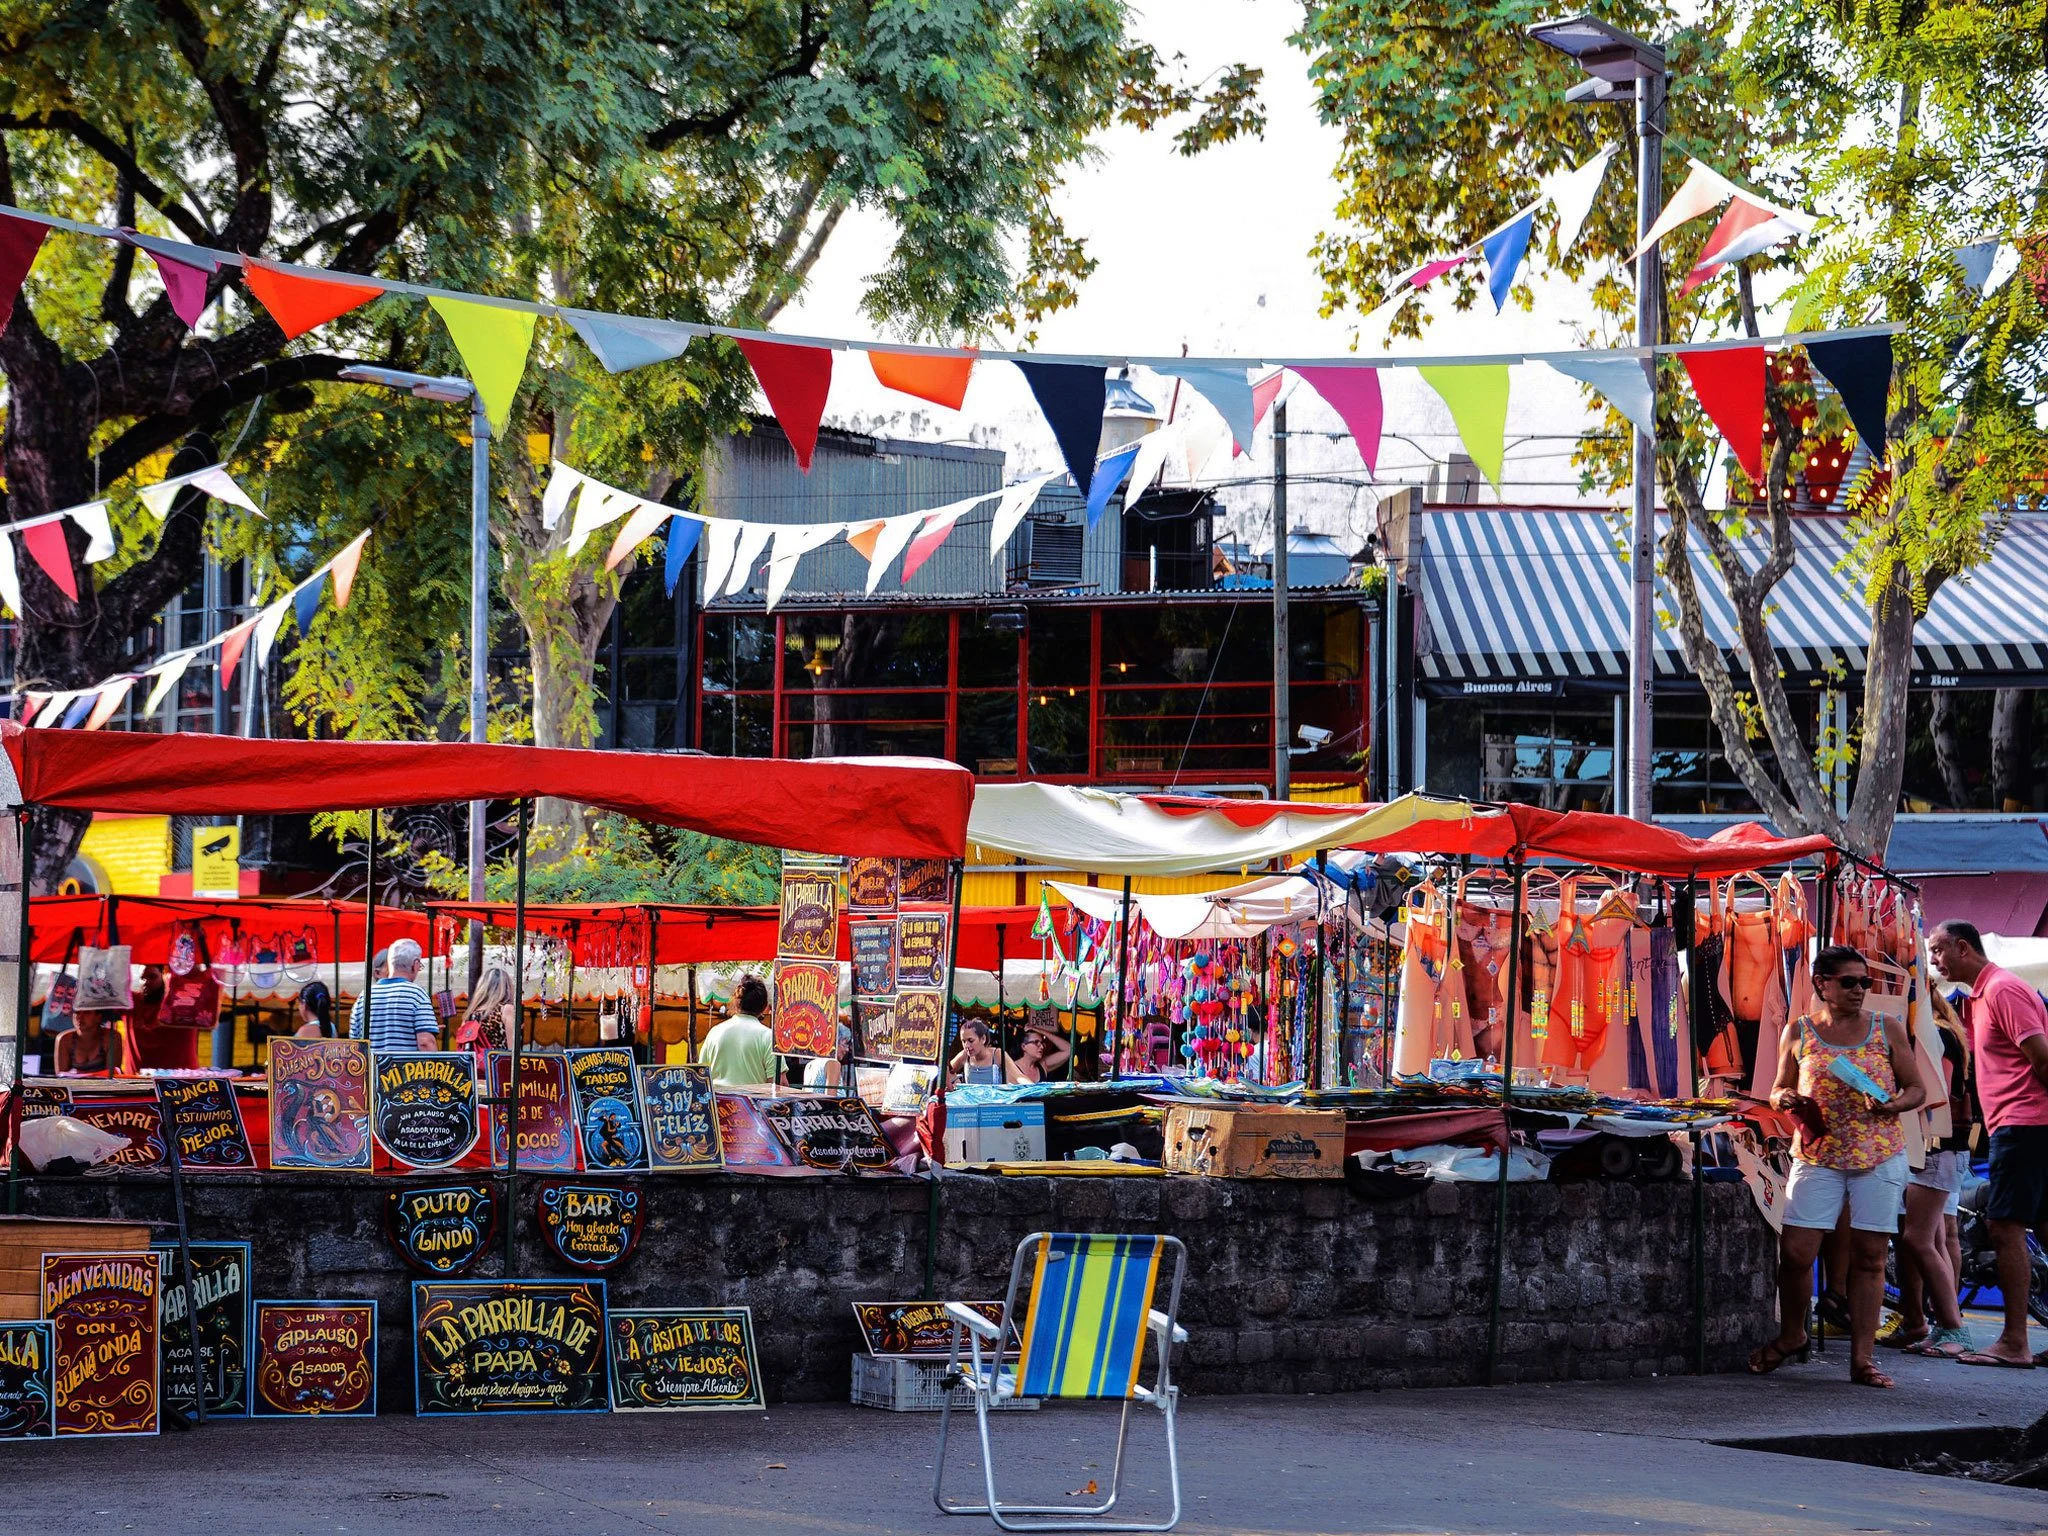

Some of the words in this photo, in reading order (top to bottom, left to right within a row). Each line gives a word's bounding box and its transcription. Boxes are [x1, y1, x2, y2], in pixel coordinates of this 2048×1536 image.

[1463, 682, 1513, 693] Buenos
[1516, 681, 1552, 693] Aires
[1930, 674, 1960, 686] Bar
[795, 881, 834, 919] PARRILLA
[782, 971, 836, 1022] PARRILLA
[276, 1049, 325, 1081] BUENOS
[519, 1058, 549, 1074] STA
[572, 1052, 604, 1077] BUENOS
[604, 1051, 629, 1067] AIRES
[380, 1064, 403, 1092] MI
[404, 1061, 472, 1098] PARRILLA
[581, 1072, 628, 1085] TANGO
[502, 1081, 558, 1103] FMILIA
[663, 1090, 694, 1113] SOY
[531, 1106, 543, 1120] DE
[801, 1099, 823, 1111] MI
[83, 1111, 160, 1131] IEMPRE
[176, 1110, 233, 1124] ESTUVIMOS
[653, 1113, 709, 1142] FELIZ
[768, 1113, 879, 1145] PARRILLA
[412, 1192, 470, 1219] PUTO
[566, 1193, 613, 1217] BAR
[418, 1227, 473, 1251] LINDO
[566, 1220, 584, 1237] Hoy
[586, 1221, 619, 1235] abierto
[599, 1235, 608, 1243] a
[571, 1238, 620, 1253] borrachos
[47, 1262, 154, 1313] BIENVENIDOS
[306, 1314, 326, 1322] UN
[425, 1319, 466, 1358] LA
[459, 1294, 566, 1341] PARRILLA
[564, 1316, 598, 1355] DE
[900, 1307, 933, 1329] BUENOS
[277, 1328, 358, 1351] APLAUSO
[617, 1338, 641, 1361] LA
[644, 1323, 694, 1356] CASITA
[695, 1320, 711, 1341] DE
[714, 1321, 741, 1345] LOS
[200, 1346, 214, 1357] SE
[55, 1351, 97, 1407] BUENA
[98, 1329, 142, 1363] ONDA
[664, 1354, 727, 1374] VIEJOS
[167, 1381, 214, 1396] MAGA
[539, 1387, 546, 1397] y
[655, 1376, 700, 1401] Siempre
[700, 1378, 740, 1393] Abierta
